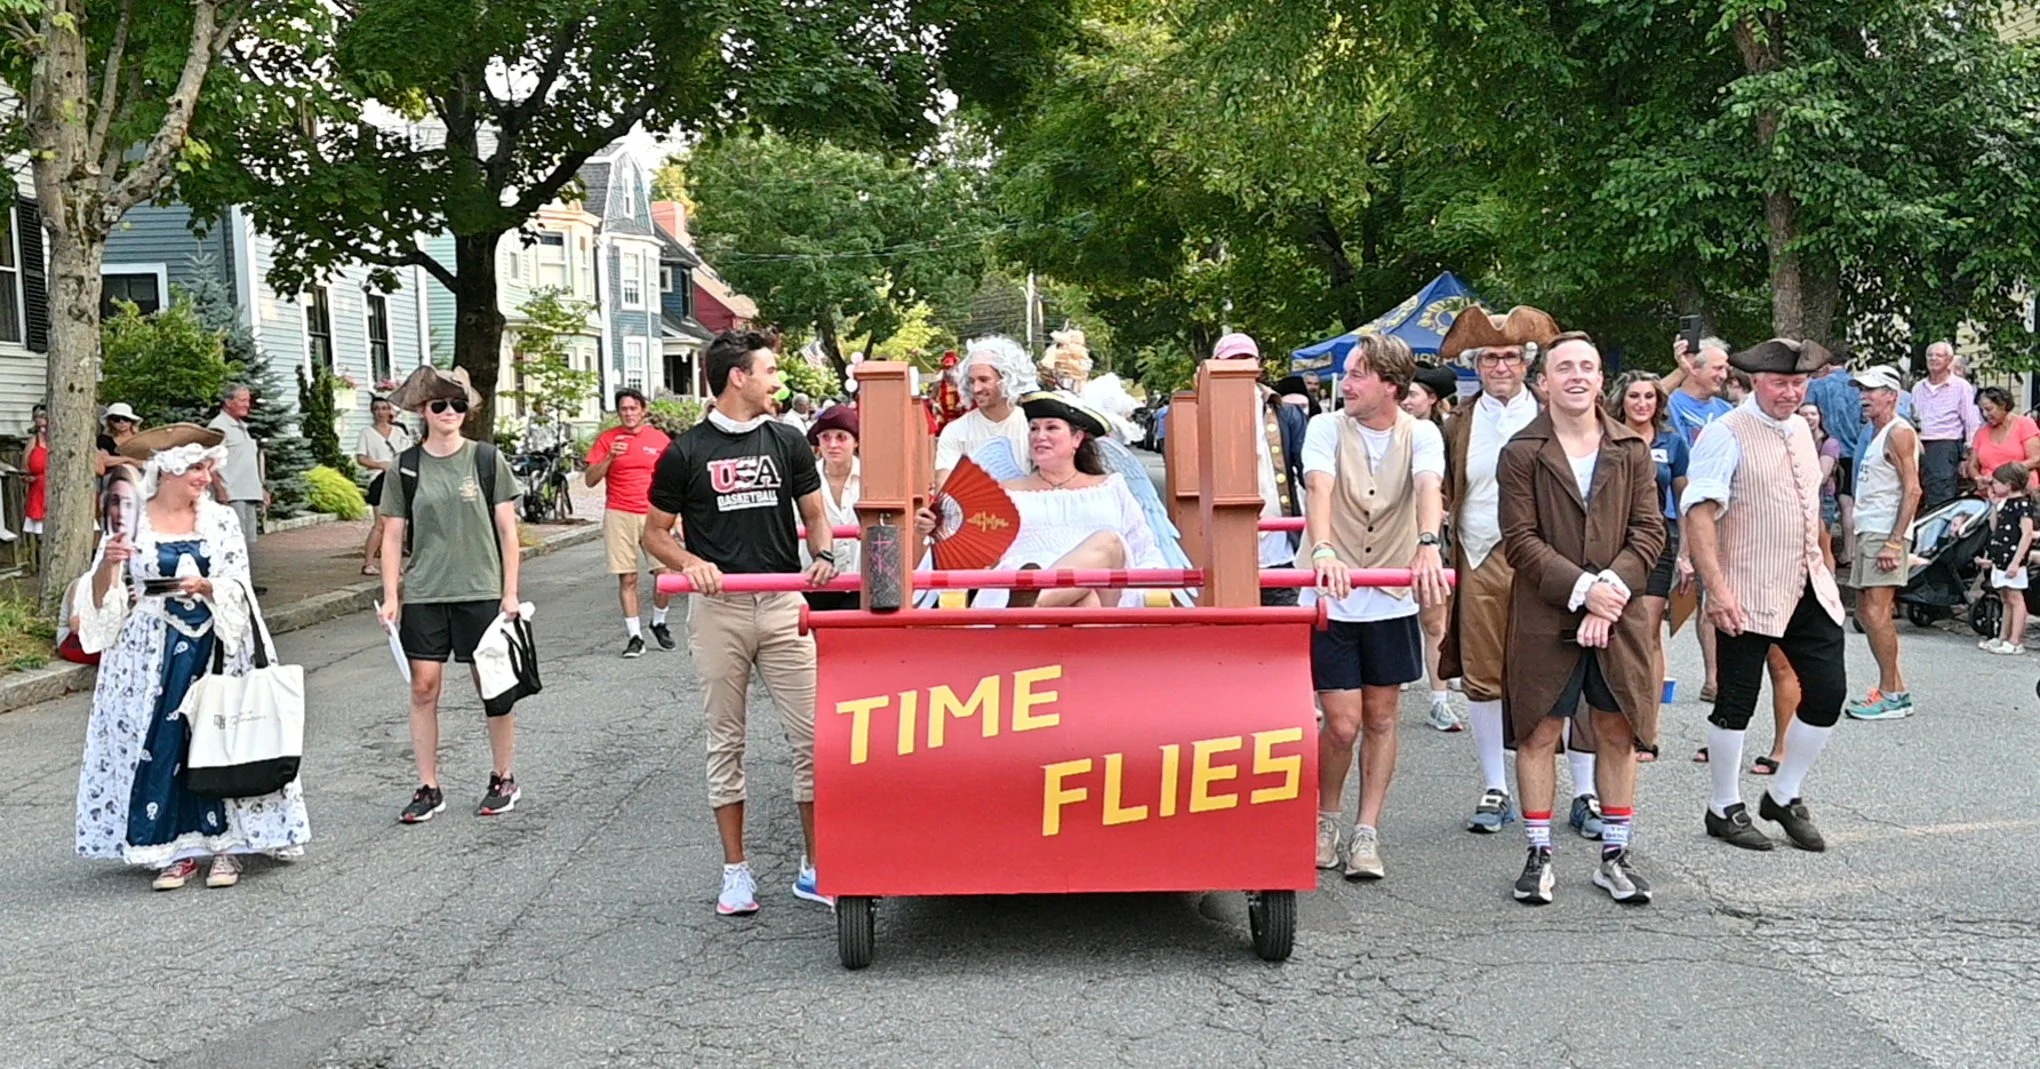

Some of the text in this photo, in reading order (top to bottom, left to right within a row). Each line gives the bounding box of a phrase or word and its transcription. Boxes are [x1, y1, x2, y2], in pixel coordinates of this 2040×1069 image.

[706, 454, 782, 493] USA
[716, 490, 778, 507] BASKETBALL
[835, 664, 1062, 765] TIME
[1040, 727, 1303, 836] FLIES
